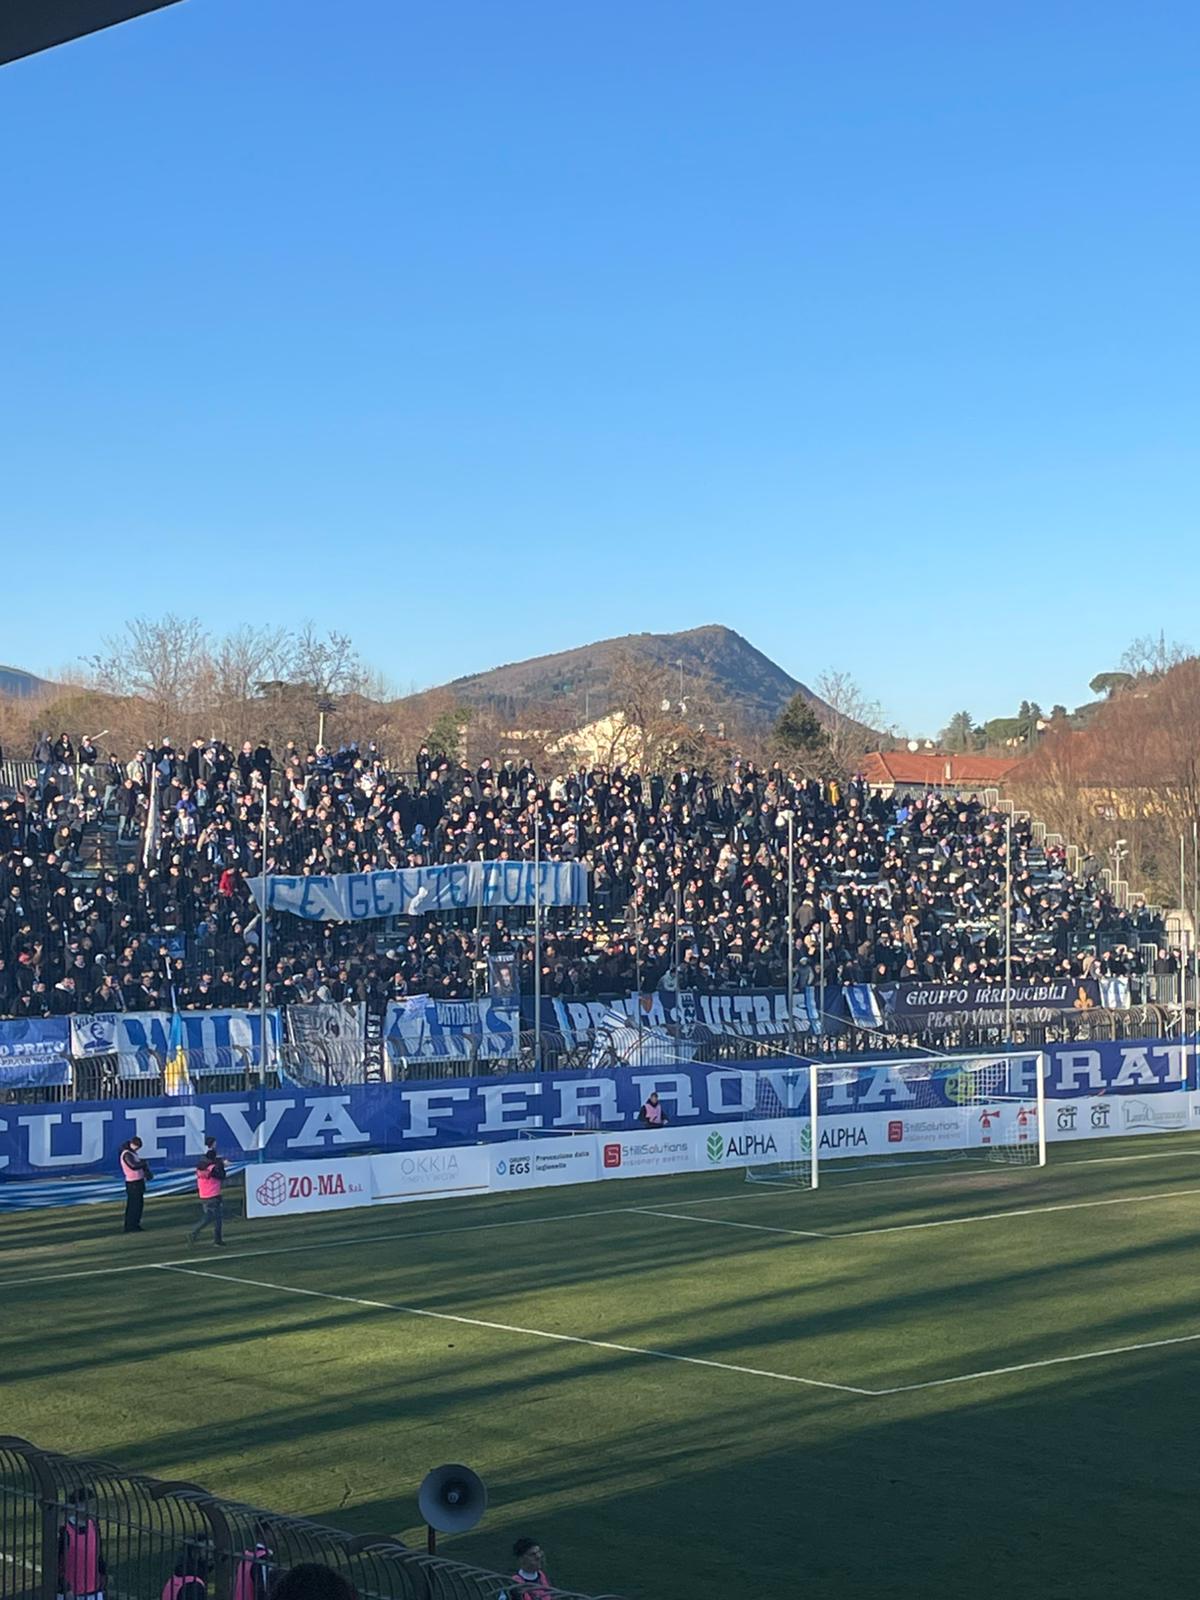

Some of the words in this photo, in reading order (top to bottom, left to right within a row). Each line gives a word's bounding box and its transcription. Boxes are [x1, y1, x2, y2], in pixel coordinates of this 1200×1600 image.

[349, 865, 468, 918] GENTE
[906, 989, 968, 1005] GRUPPO
[975, 985, 1067, 1003] IRRIDUCIBILI
[927, 1010, 968, 1027] PRATO
[13, 1041, 65, 1056] PRATO
[0, 1096, 370, 1168] URVA
[402, 1064, 918, 1139] FERROVIA
[1009, 1044, 1200, 1093] PRAT
[1057, 1112, 1077, 1129] GT
[1091, 1110, 1110, 1127] GT
[726, 1133, 777, 1157] ALPHA
[818, 1126, 868, 1148] ALPHA
[401, 1154, 458, 1175] OKKIA
[509, 1163, 530, 1175] EGS
[288, 1174, 346, 1198] ZO-MA
